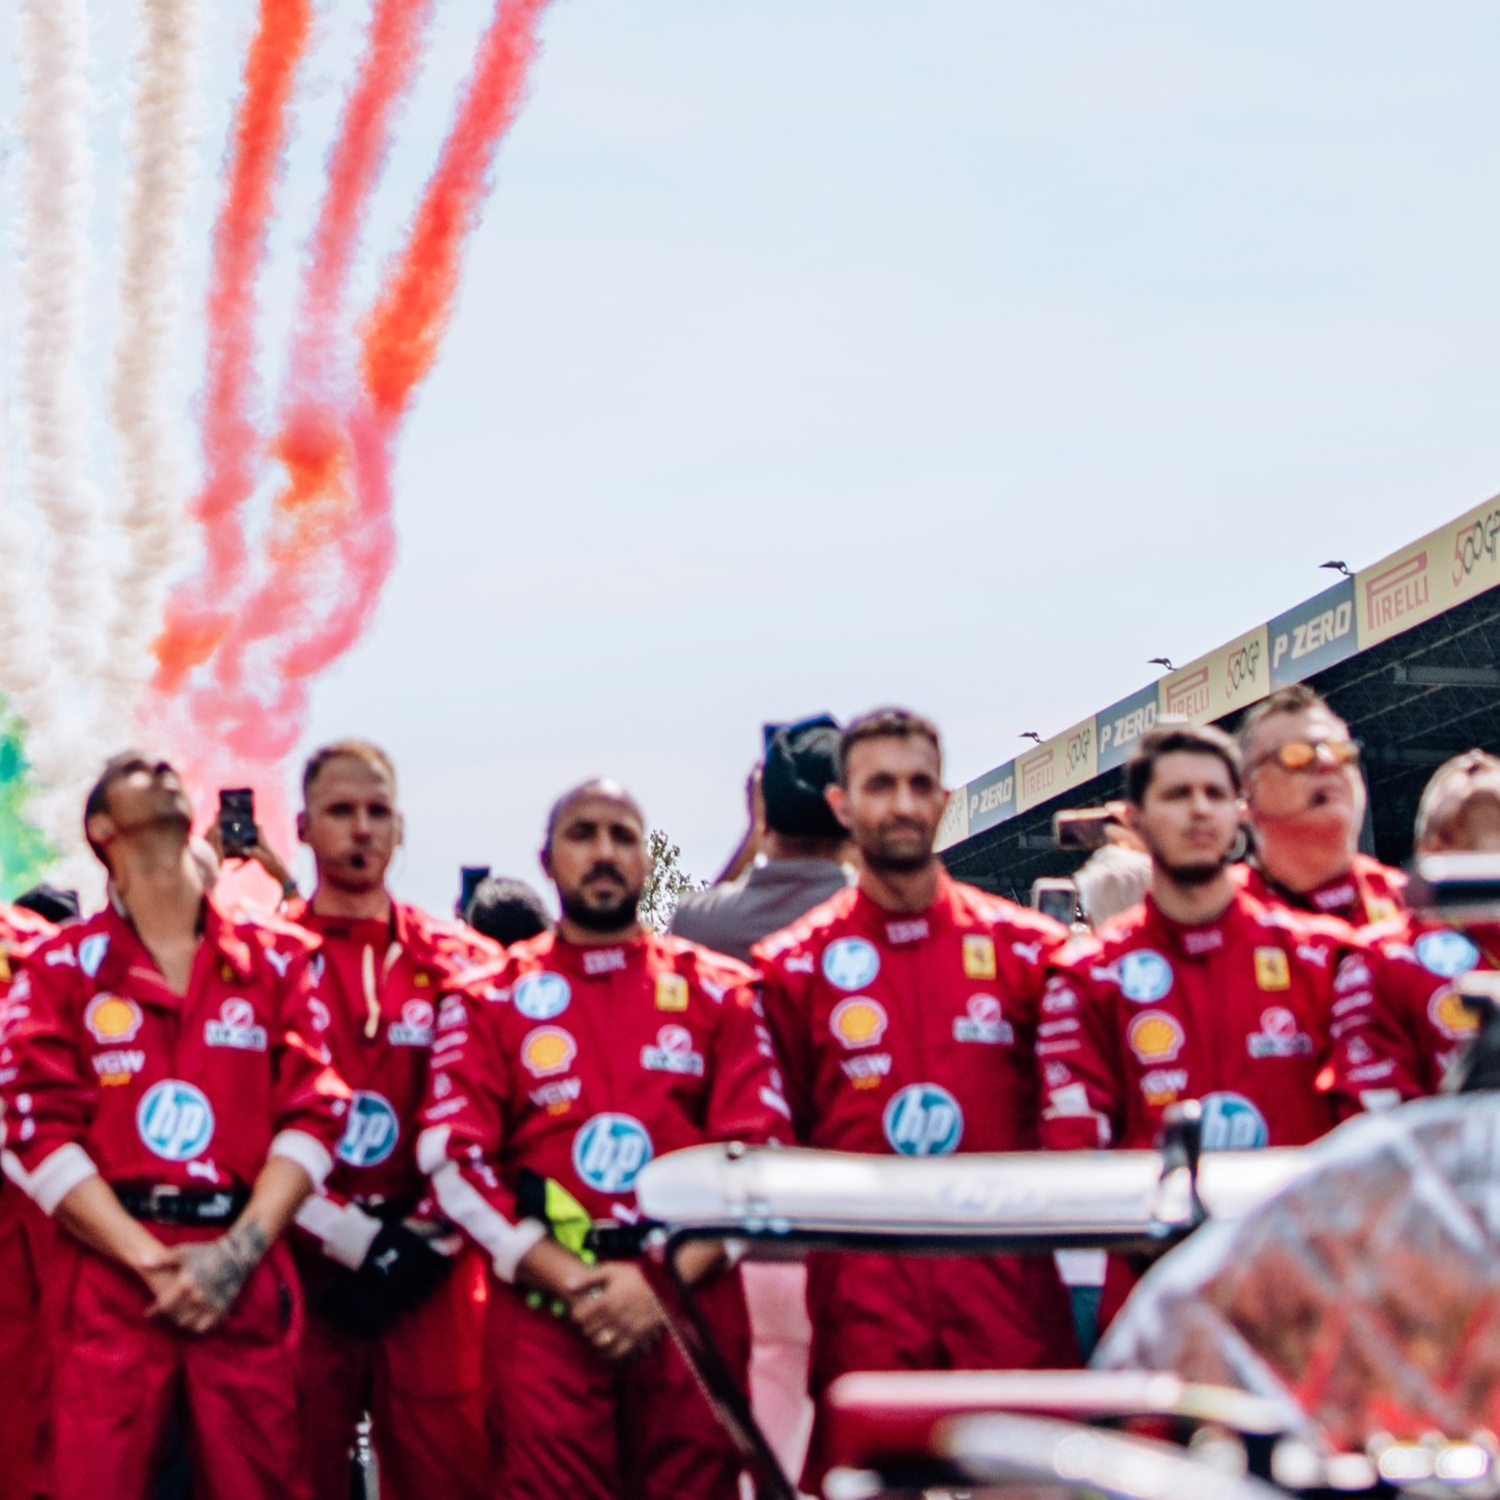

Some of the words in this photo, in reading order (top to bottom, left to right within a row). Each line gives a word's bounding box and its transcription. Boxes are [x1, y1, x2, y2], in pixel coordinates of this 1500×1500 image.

[1365, 550, 1429, 631] PIRELLI
[1272, 633, 1289, 670] P
[1290, 600, 1353, 661] ZERO
[1165, 666, 1210, 718] PIRELLI
[1100, 724, 1112, 755] P
[1113, 701, 1157, 748] ZERO
[969, 794, 979, 820] P
[979, 775, 1013, 815] ZERO
[1022, 748, 1054, 800] PIRELLI
[147, 1081, 206, 1159] hp
[583, 1114, 642, 1192] hp
[896, 1085, 951, 1155] hp
